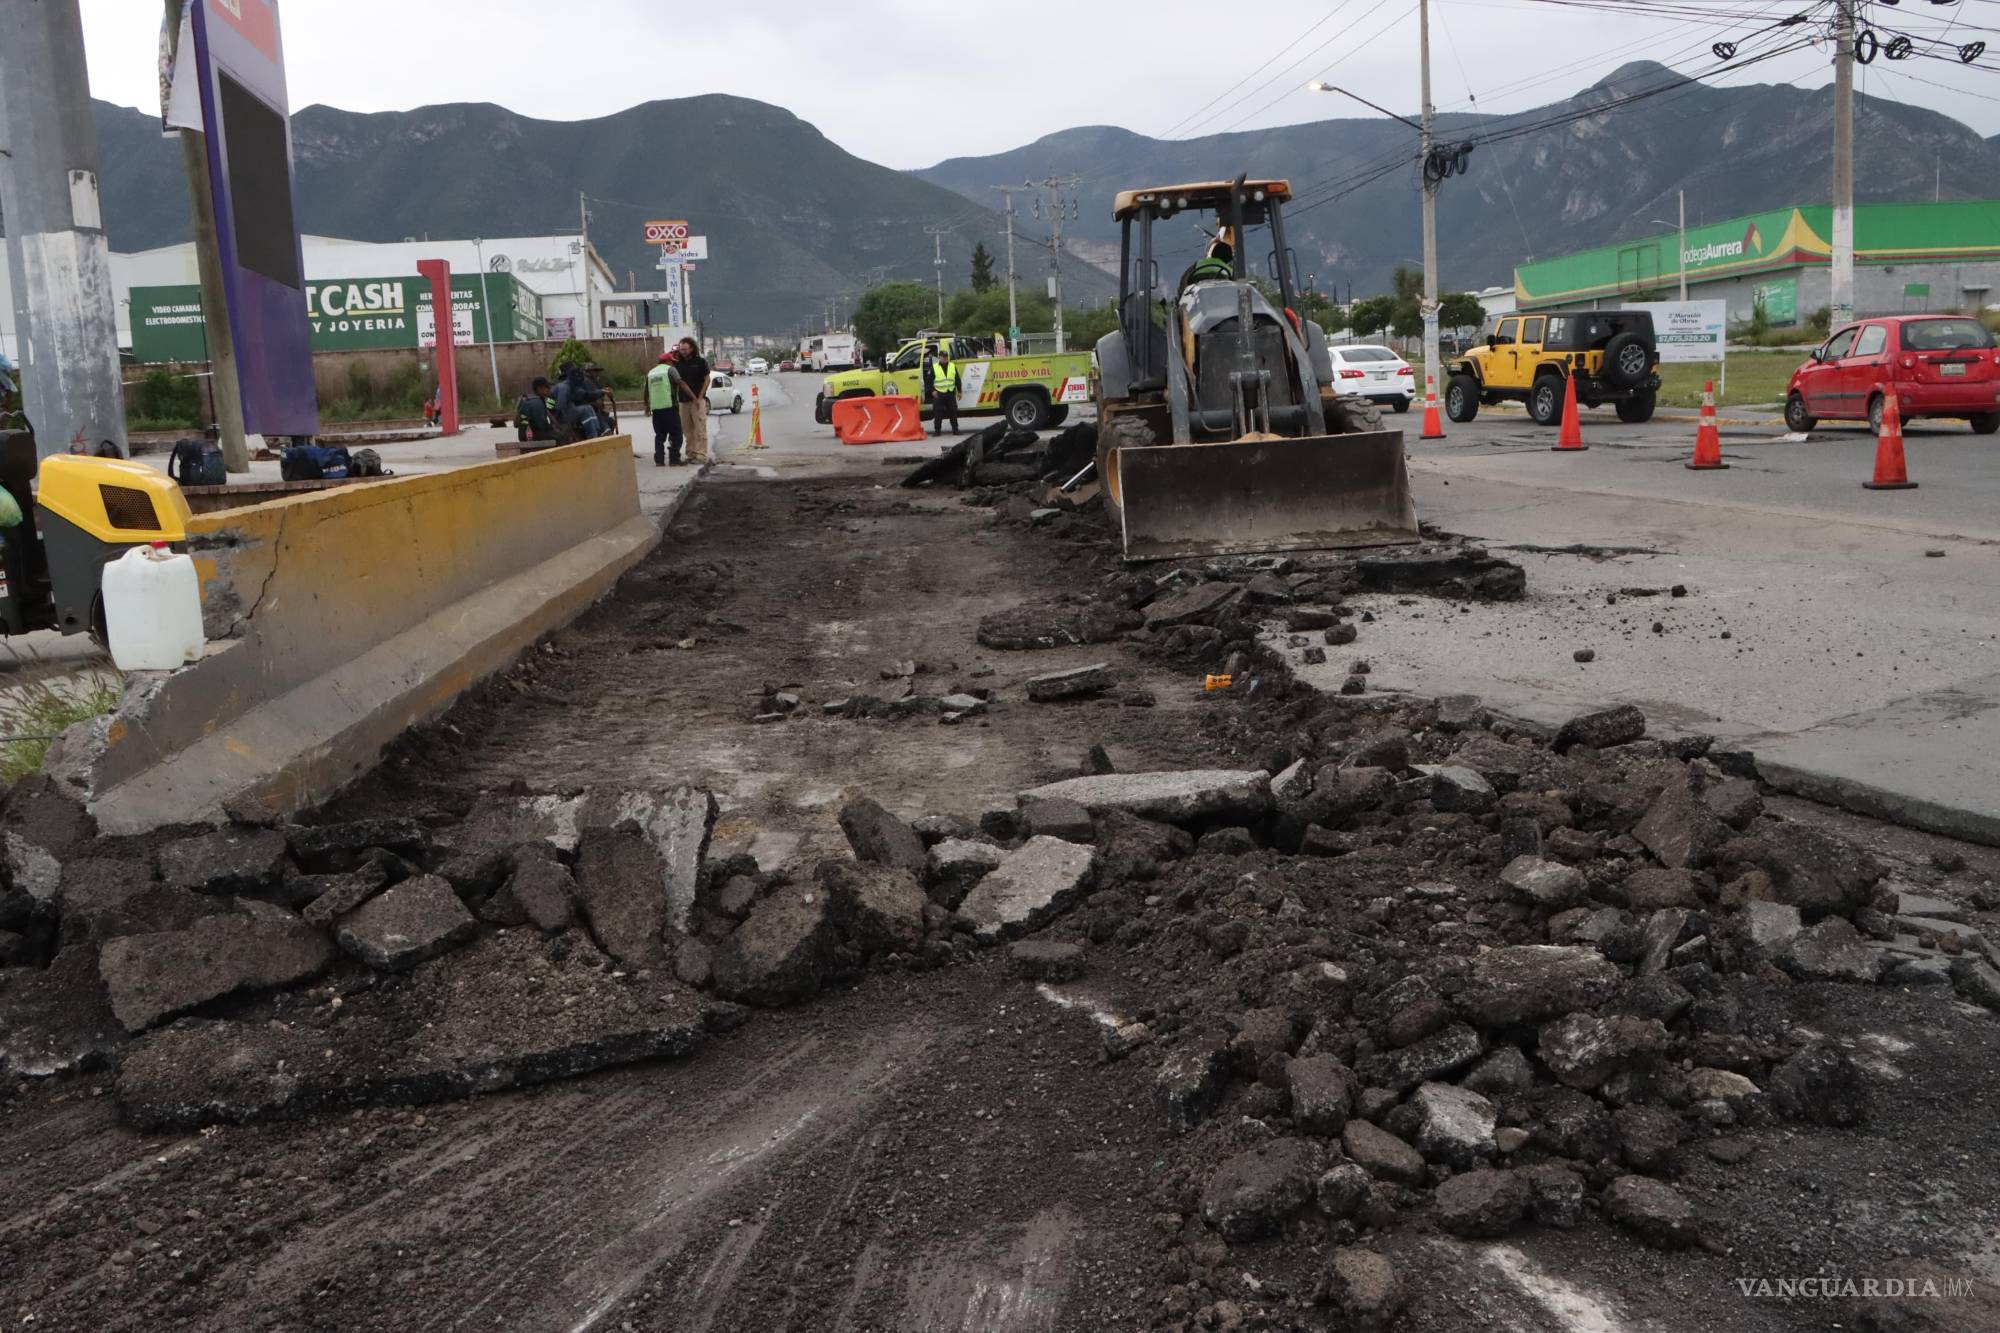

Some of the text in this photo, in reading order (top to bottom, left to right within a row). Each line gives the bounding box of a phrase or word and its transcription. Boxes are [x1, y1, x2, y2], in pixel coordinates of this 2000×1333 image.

[646, 225, 688, 240] OXXO
[320, 282, 404, 316] CASH
[419, 290, 473, 301] HERENTAS
[416, 302, 480, 312] COMDORAS
[312, 318, 405, 333] Y JOYERIA
[992, 368, 1051, 379] AUXILIO VIAL
